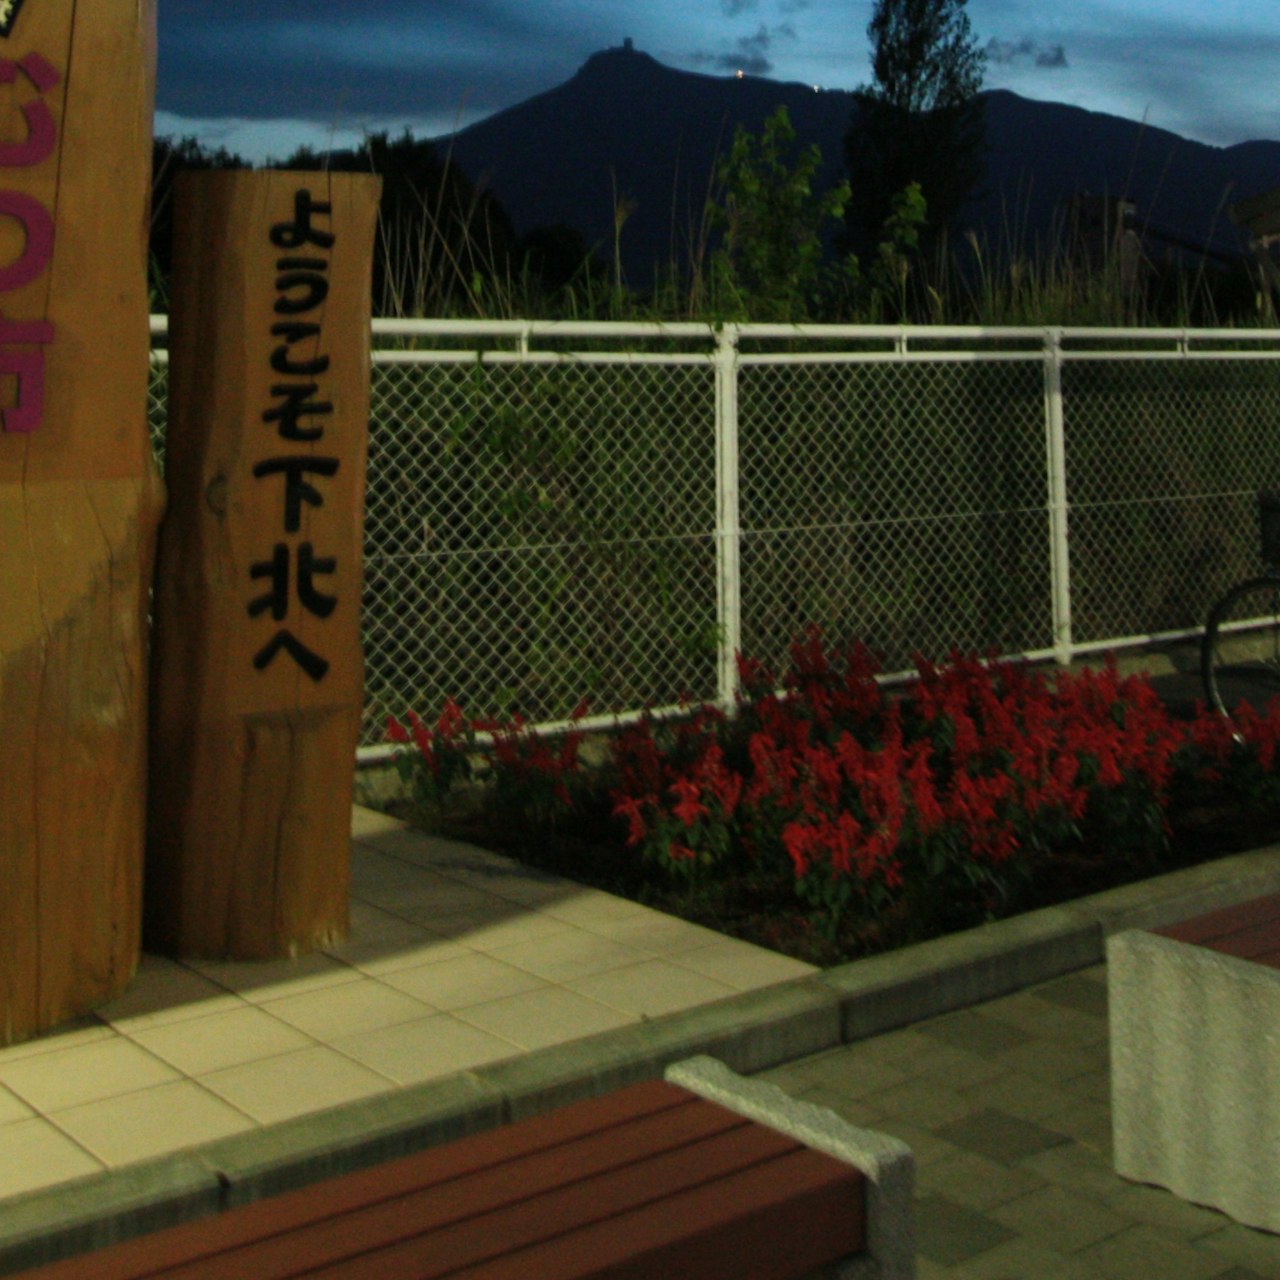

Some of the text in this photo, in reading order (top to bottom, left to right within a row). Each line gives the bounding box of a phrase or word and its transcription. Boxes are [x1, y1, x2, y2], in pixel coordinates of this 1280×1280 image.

[248, 189, 340, 681] ようこそ下北へ
